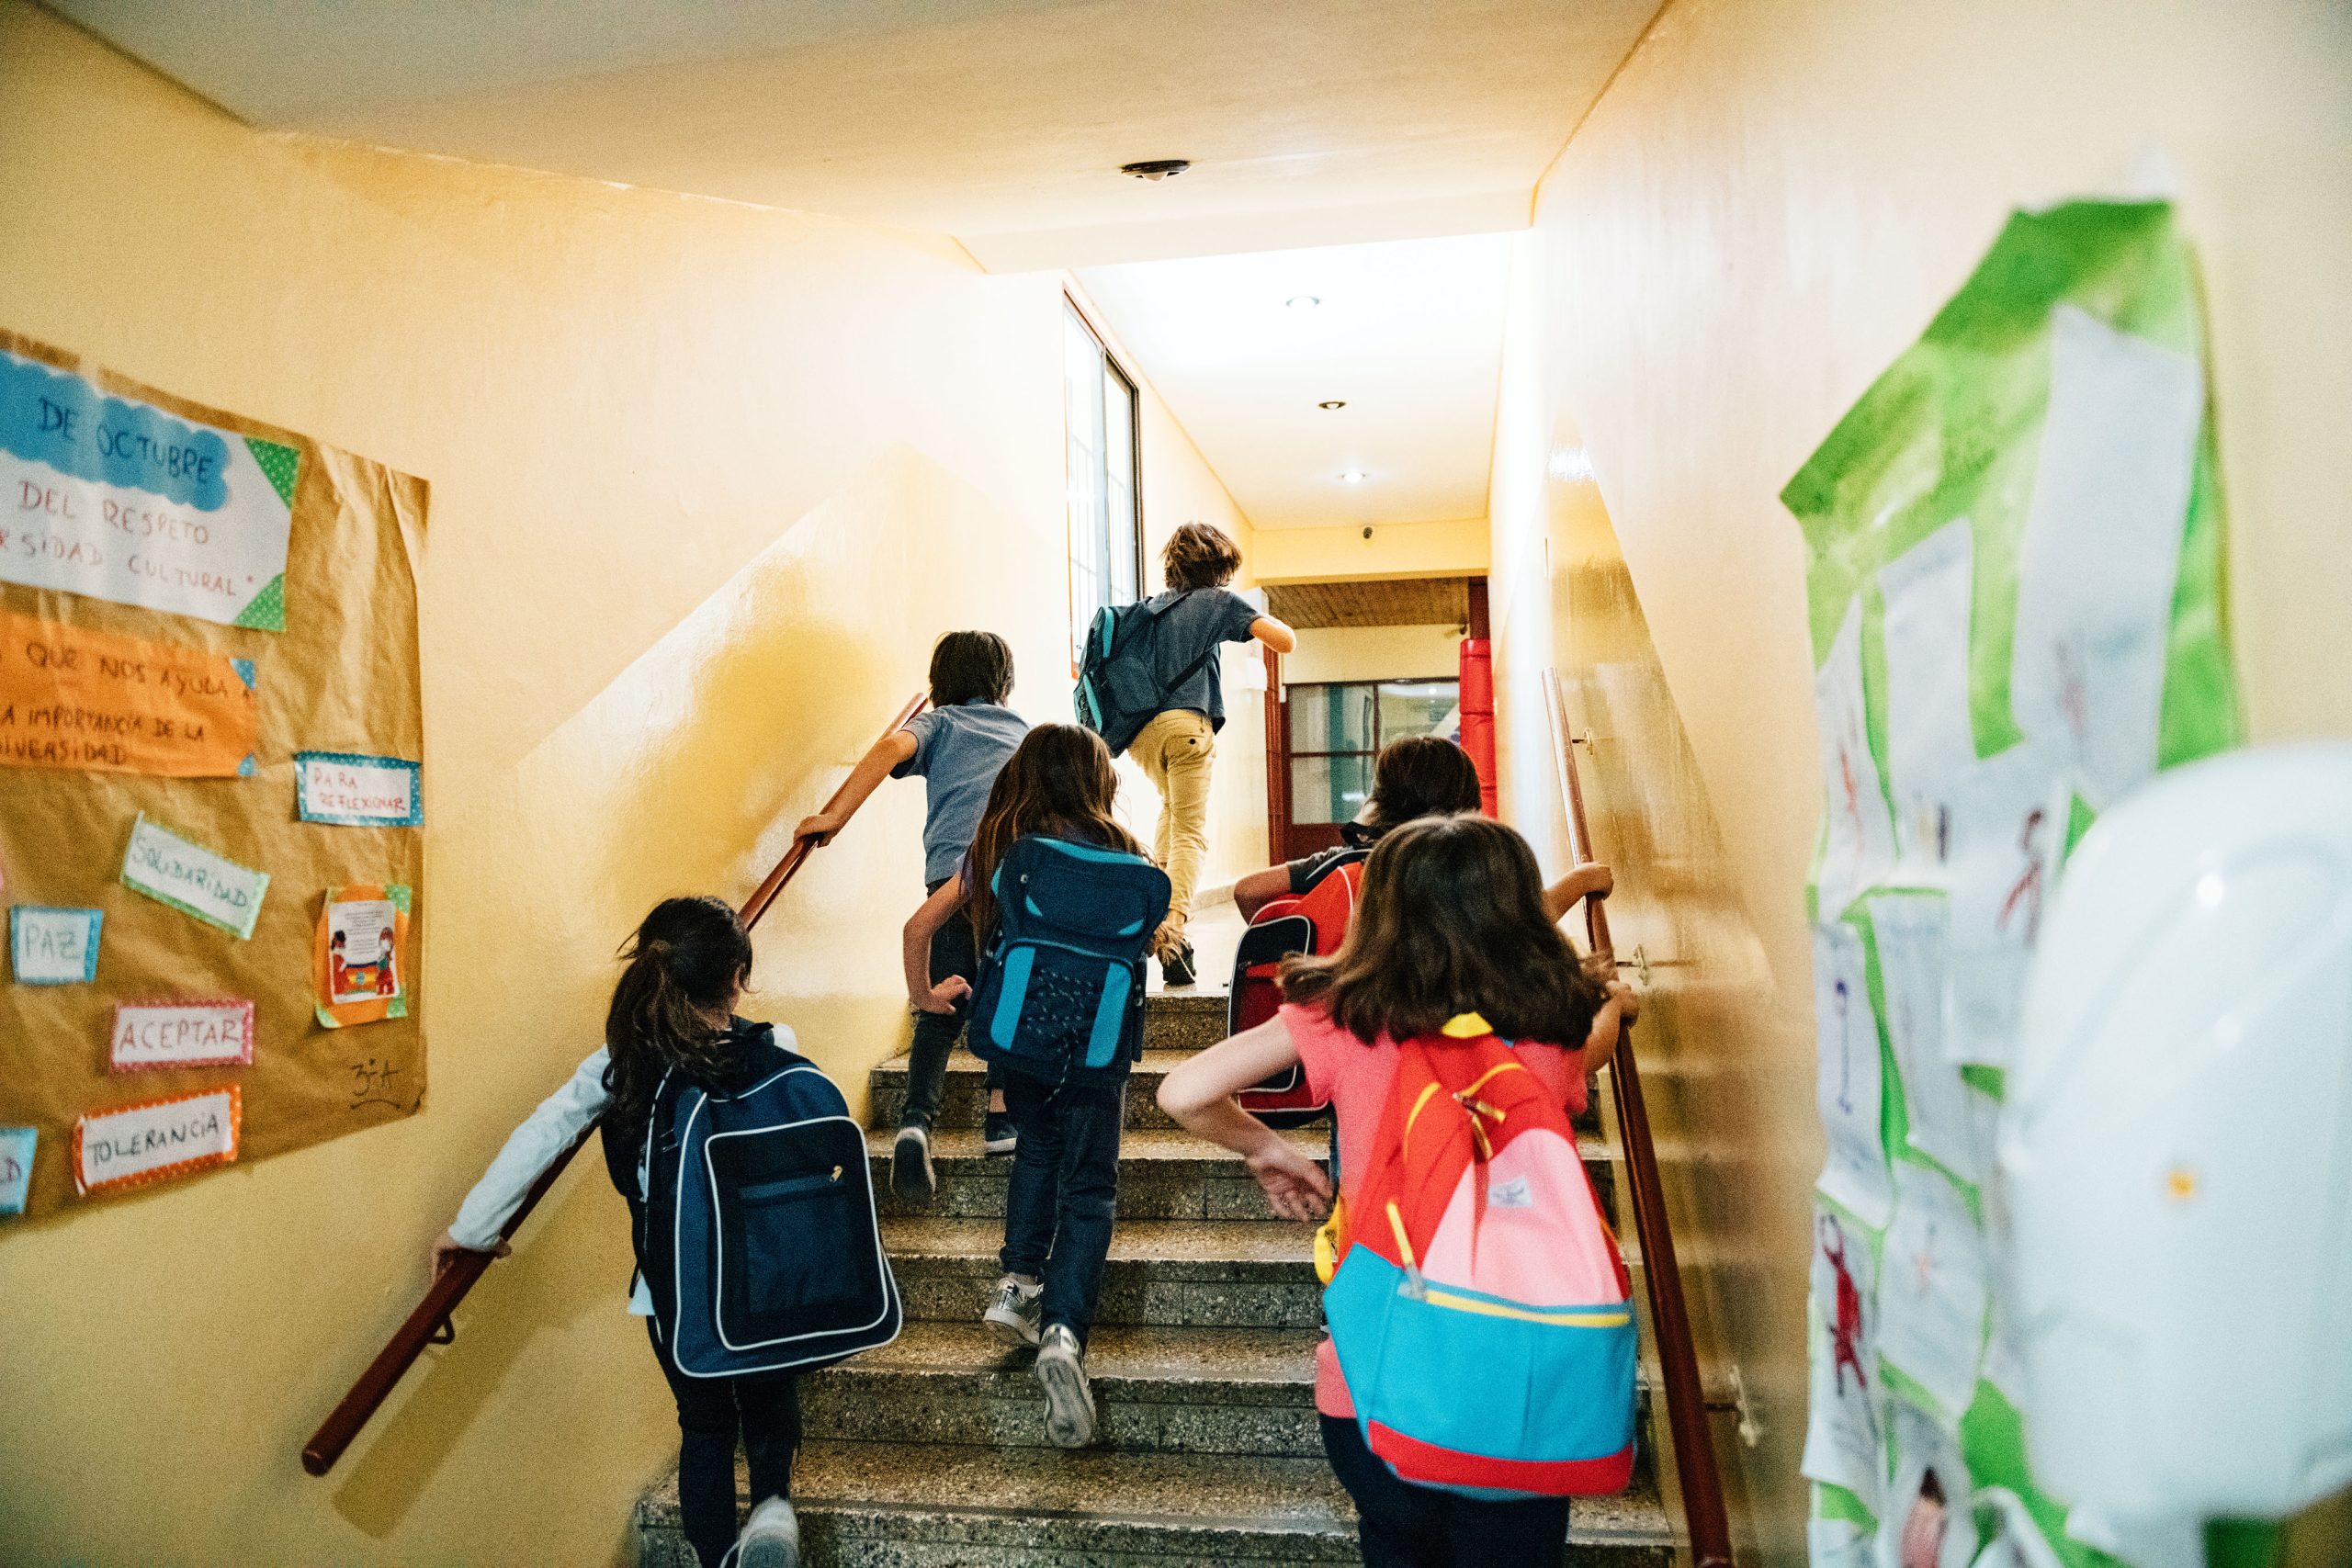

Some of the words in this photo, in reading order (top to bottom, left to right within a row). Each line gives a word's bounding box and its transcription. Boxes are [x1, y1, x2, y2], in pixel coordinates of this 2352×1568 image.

[38, 396, 79, 443] DE
[96, 423, 213, 484] OCTUBRE
[18, 479, 76, 519] DEL
[103, 498, 210, 545] RESPETO
[26, 642, 77, 671] QUE
[100, 655, 146, 683] NOS
[313, 767, 357, 789] PARA
[25, 922, 81, 960] PAZ
[119, 1019, 241, 1051] ACEPTAR
[86, 1112, 220, 1167] TOLERANCIA
